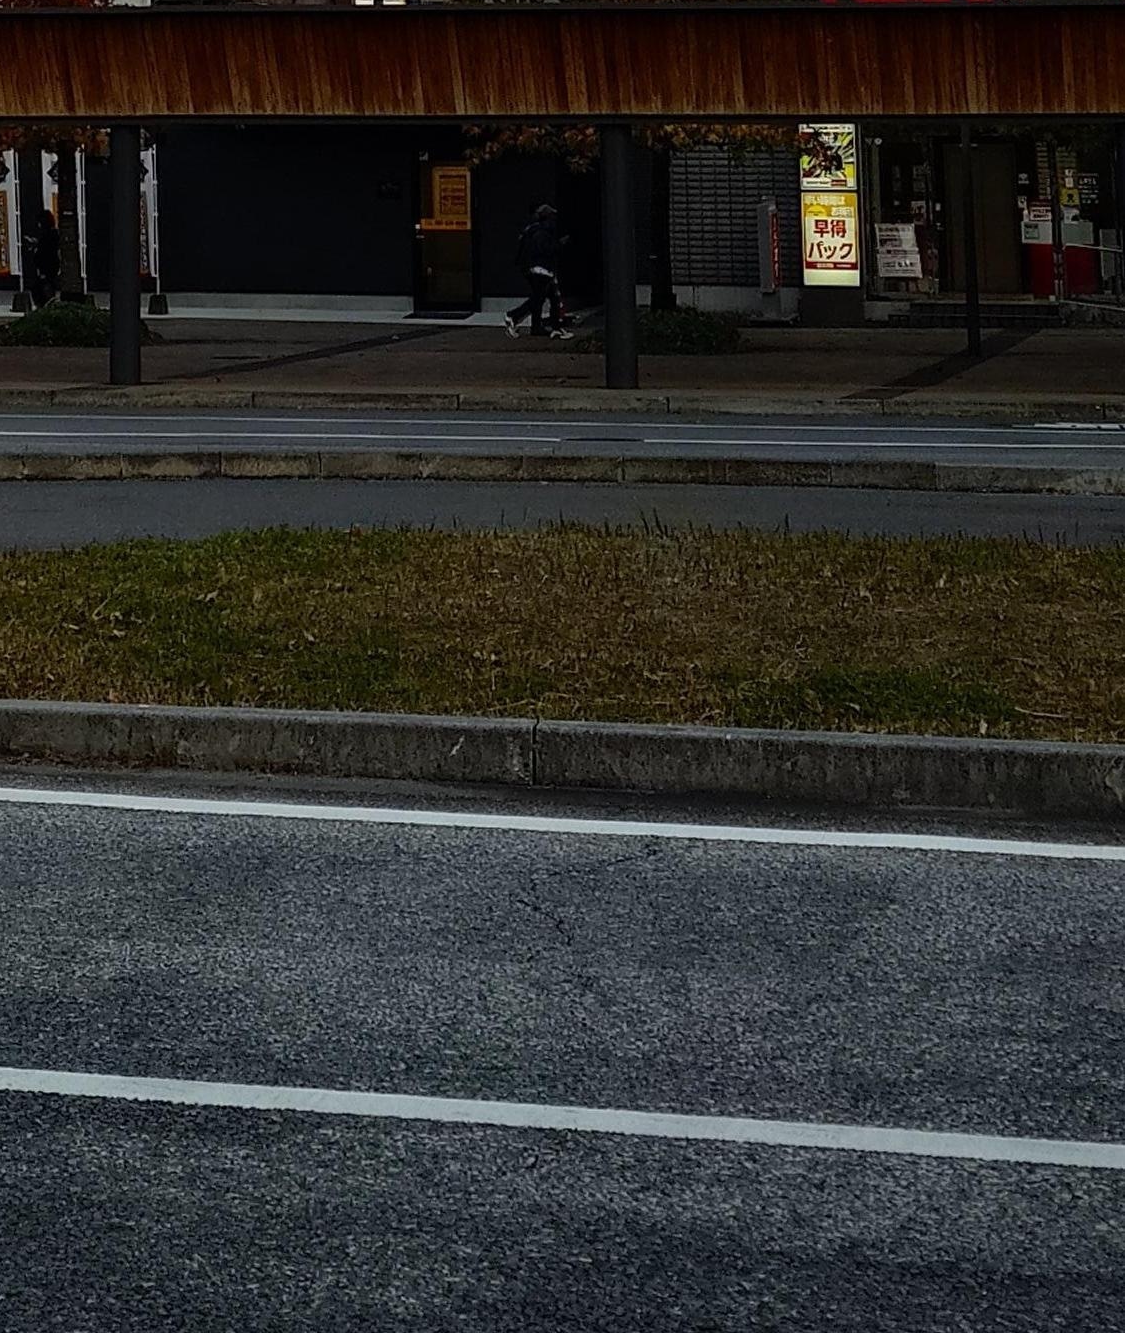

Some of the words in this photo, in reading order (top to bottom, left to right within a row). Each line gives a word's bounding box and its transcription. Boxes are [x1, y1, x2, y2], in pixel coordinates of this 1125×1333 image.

[813, 219, 847, 238] 早得
[808, 241, 854, 260] パック
